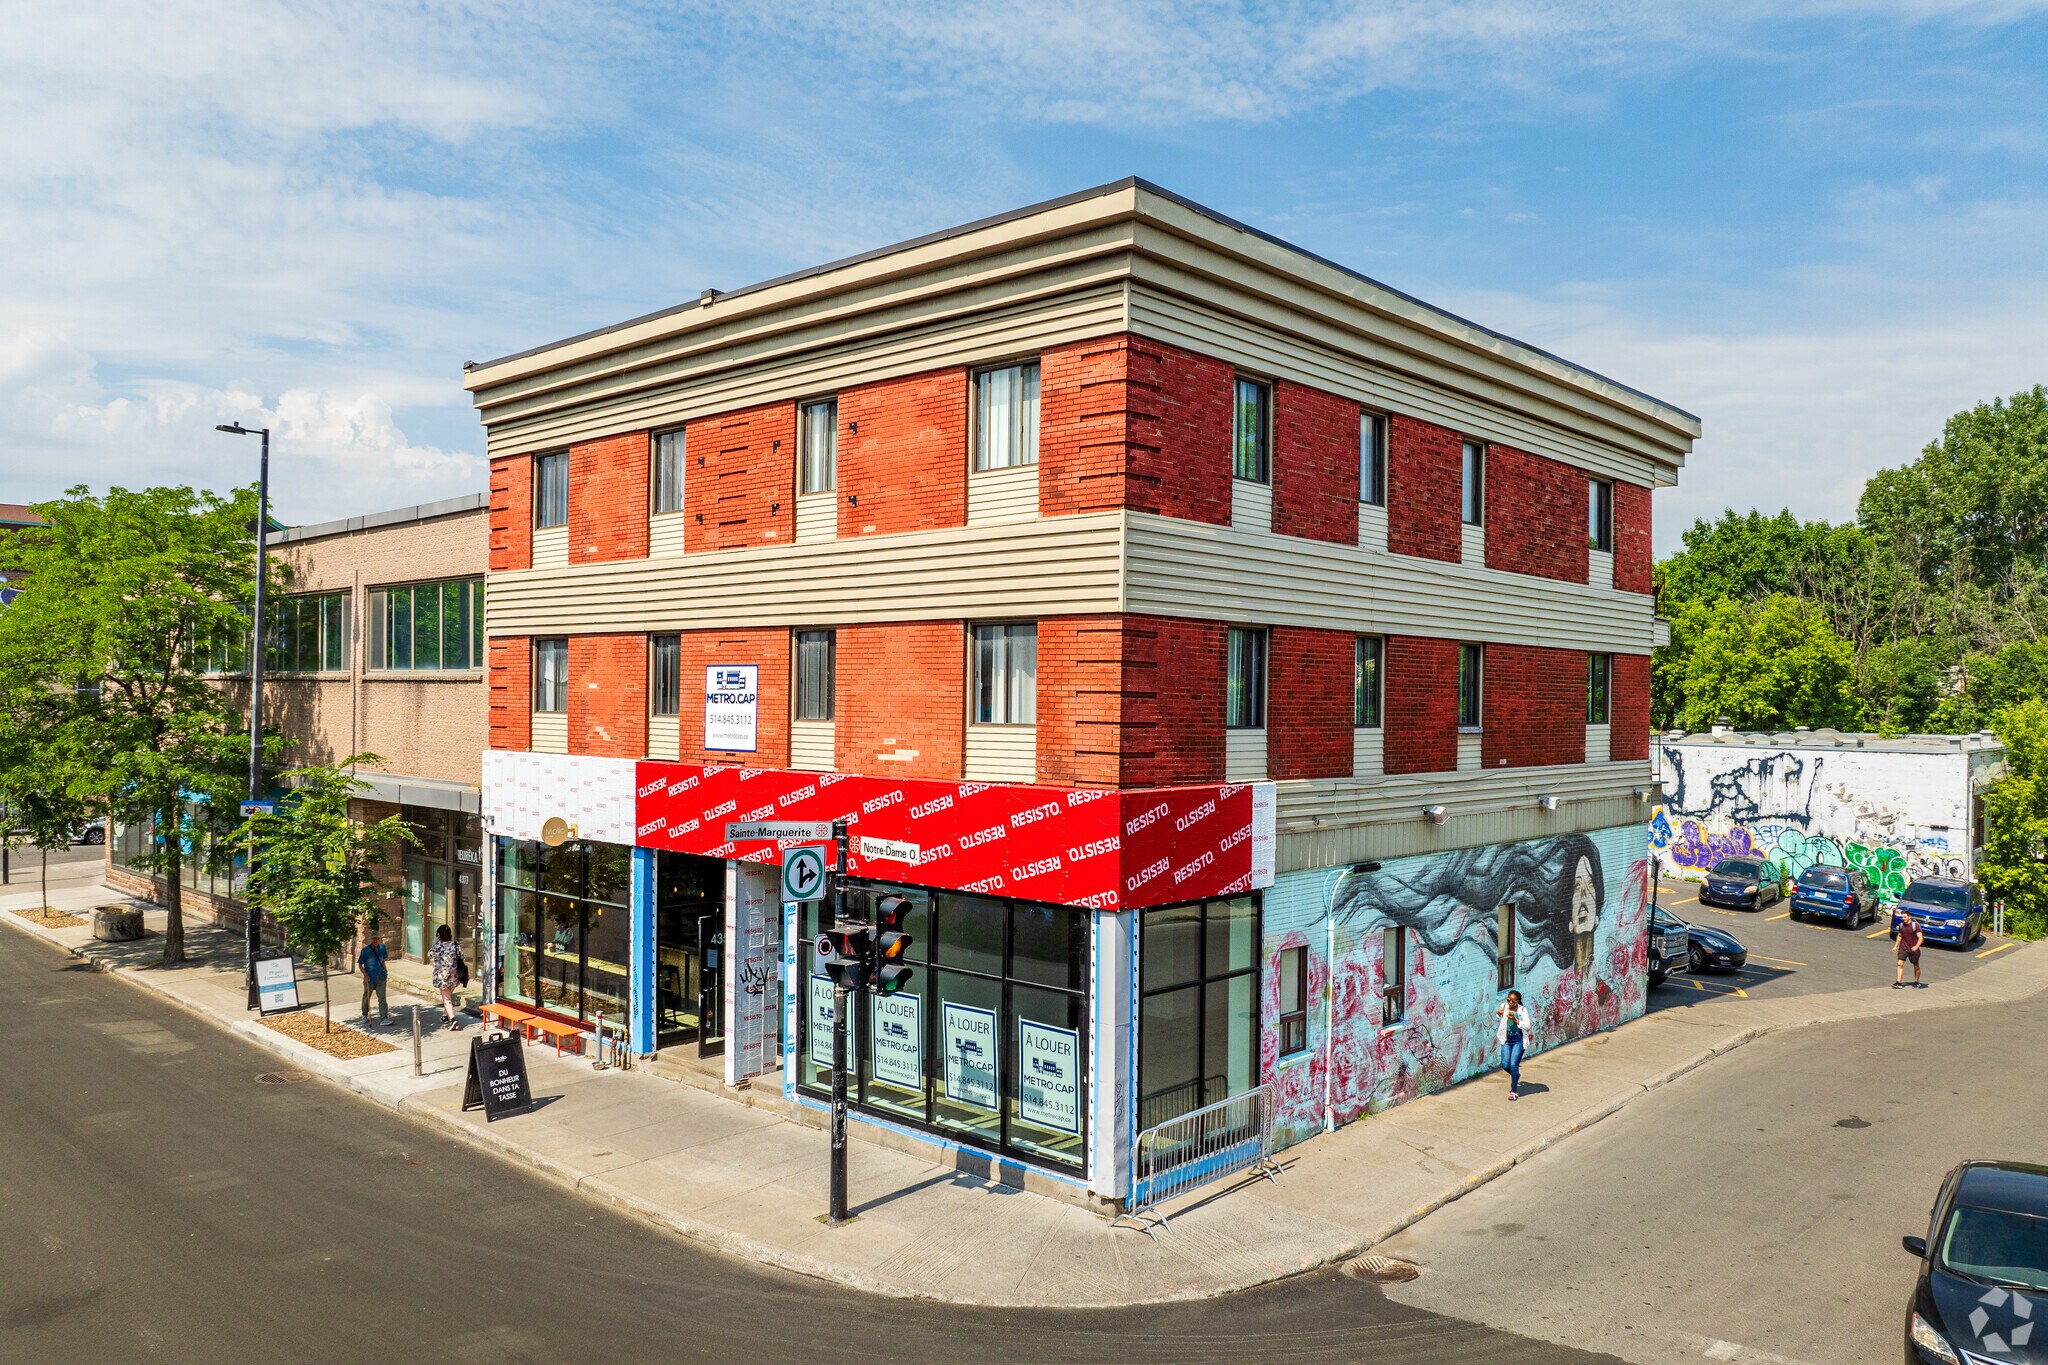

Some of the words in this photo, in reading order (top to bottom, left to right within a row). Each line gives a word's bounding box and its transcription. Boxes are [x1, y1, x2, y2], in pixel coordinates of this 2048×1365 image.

[706, 693, 755, 704] METRO.CAP
[709, 714, 752, 725] 514.845.3112
[729, 827, 811, 839] Sainte-Marguerite
[863, 842, 907, 859] Notre-Dame
[909, 849, 918, 861] O.
[711, 932, 724, 945] 43
[877, 999, 884, 1012] À
[885, 1003, 915, 1019] LOUER
[949, 1014, 956, 1028] À
[957, 1017, 990, 1035] LOUER
[876, 1038, 918, 1054] METRO.CAP
[1025, 1032, 1033, 1048] À
[1035, 1036, 1071, 1056] LOUER
[877, 1055, 918, 1073] 514.845.3112
[948, 1054, 993, 1072] METRO.CAP
[490, 1075, 520, 1087] BONHEUR
[498, 1069, 508, 1077] DU
[492, 1085, 511, 1095] DANS
[949, 1073, 994, 1091] 514.845.3112
[1023, 1074, 1075, 1095] METRO.CAP
[498, 1092, 517, 1102] TASSE
[1023, 1094, 1075, 1115] 514.845.3112
